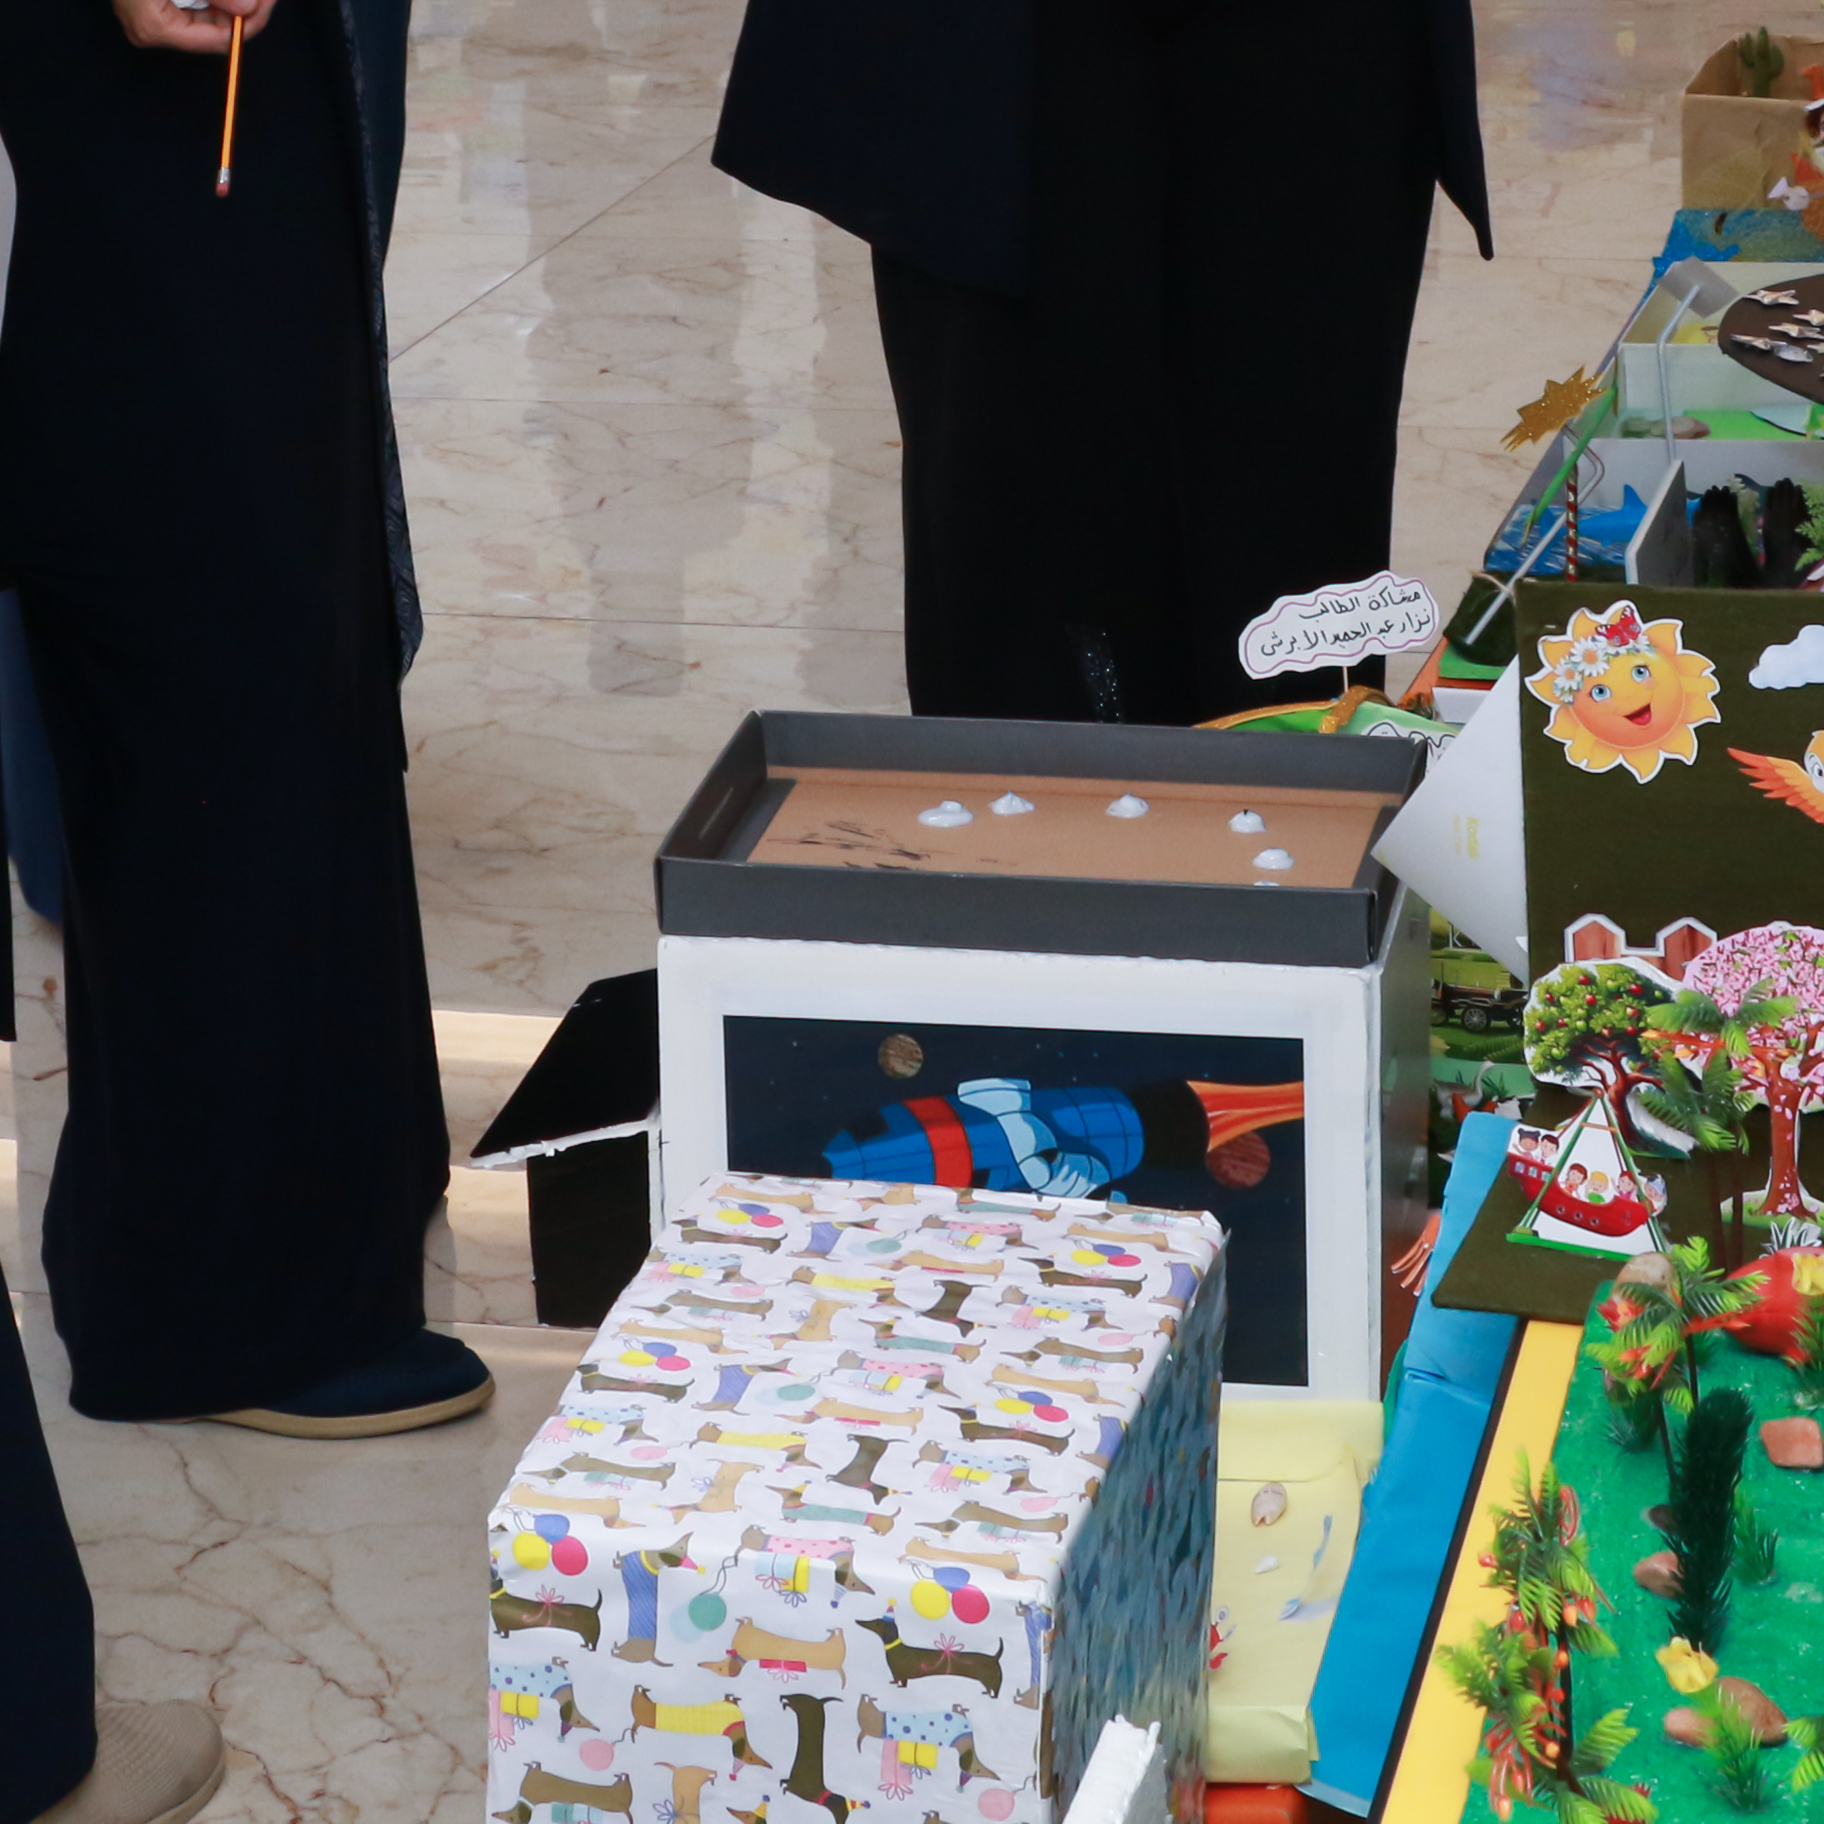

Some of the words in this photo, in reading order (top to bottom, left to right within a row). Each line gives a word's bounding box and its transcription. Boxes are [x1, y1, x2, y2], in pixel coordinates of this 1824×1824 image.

[1298, 596, 1361, 624] الطالب
[1399, 608, 1431, 634] نزار
[1329, 621, 1372, 649] الحميد
[1377, 619, 1395, 639] عبد
